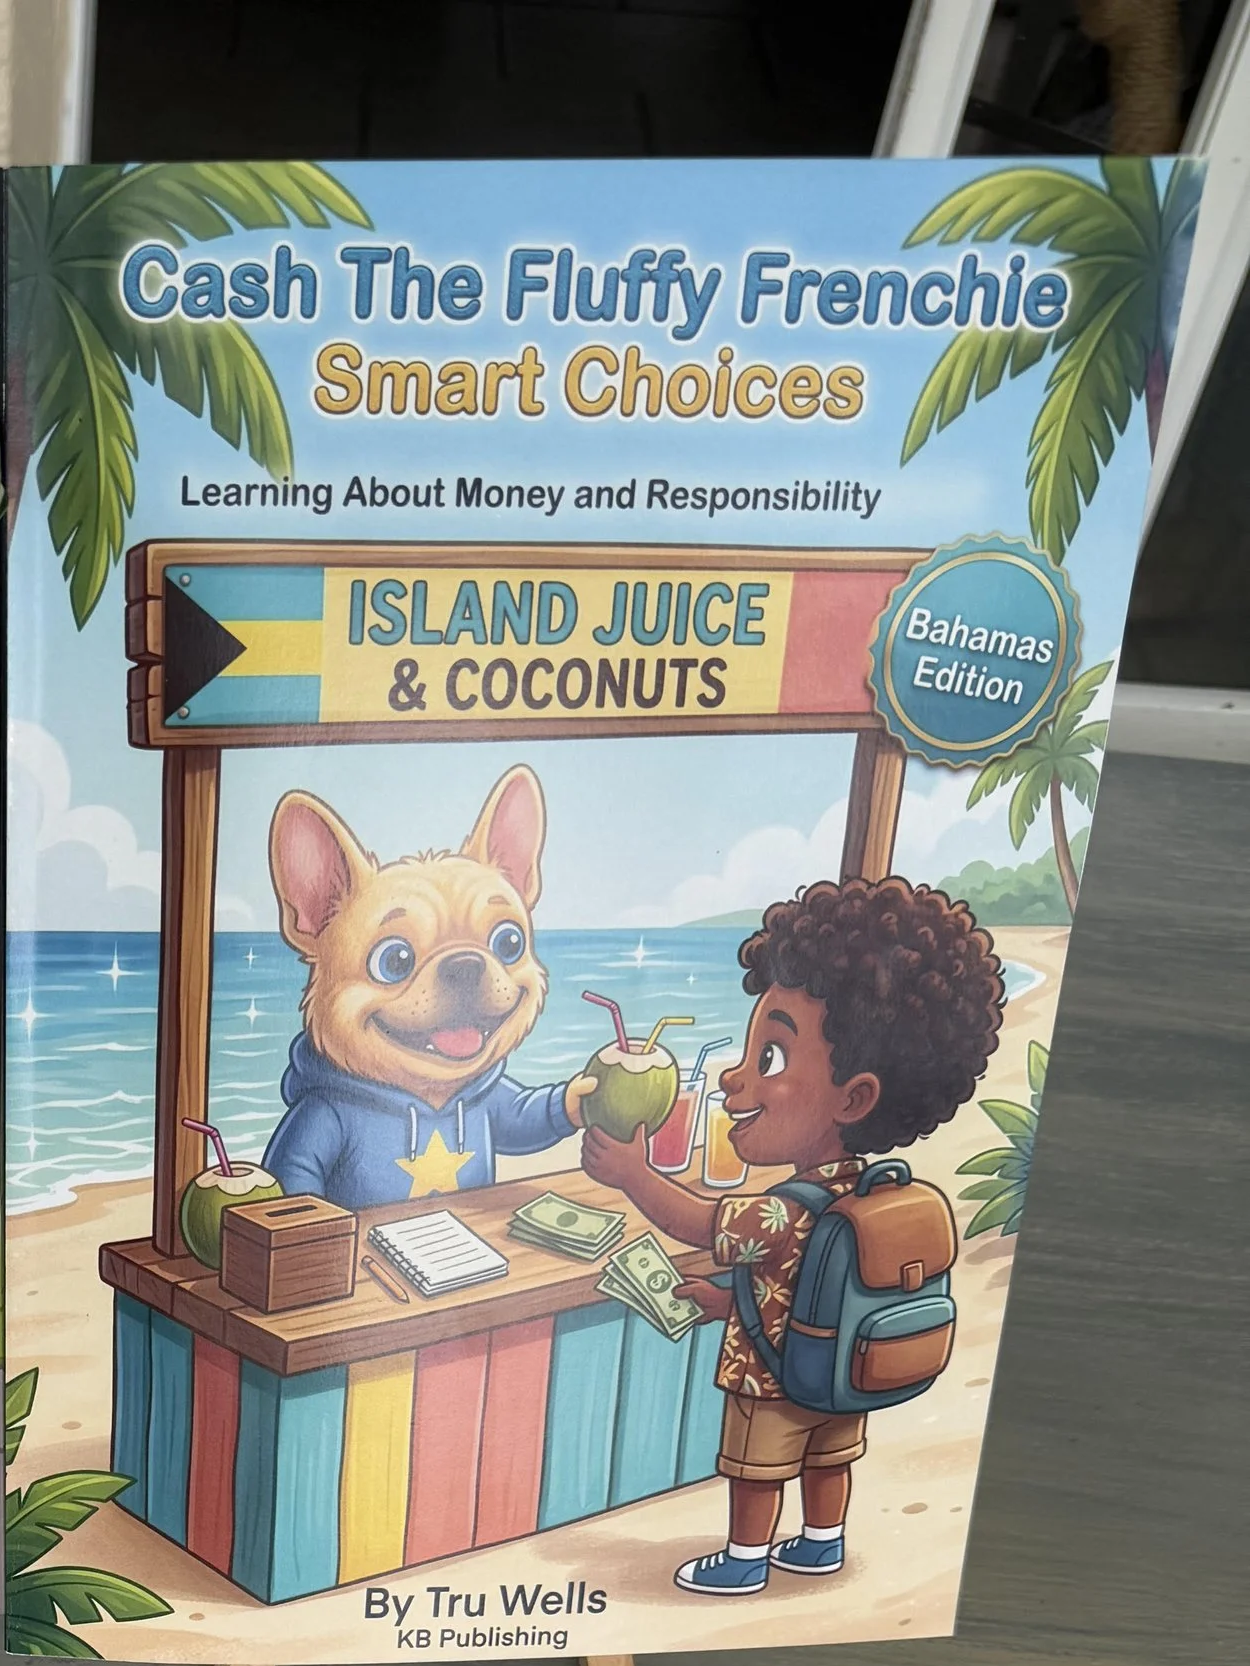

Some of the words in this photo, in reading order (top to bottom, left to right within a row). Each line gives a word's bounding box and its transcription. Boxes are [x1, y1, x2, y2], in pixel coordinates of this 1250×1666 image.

[120, 243, 317, 323] Cash
[340, 246, 481, 324] The
[504, 247, 720, 341] Fluffy
[741, 251, 1069, 333] Frenchie
[313, 341, 545, 418] Smart
[564, 345, 864, 421] Choices
[180, 475, 333, 515] Learning
[343, 477, 446, 510] About
[454, 478, 565, 516] Money
[573, 480, 637, 511] and
[645, 480, 881, 520] Responsibility
[347, 578, 577, 648] ISLAND
[591, 579, 770, 646] JUICE
[905, 607, 1055, 666] Bahamas
[387, 658, 428, 710] &
[445, 658, 727, 710] COCONUTS
[911, 658, 1024, 706] Edition
[364, 1587, 414, 1626] By
[426, 1586, 485, 1618] Tru
[499, 1581, 607, 1616] Wells
[397, 1629, 431, 1649] KB
[439, 1626, 569, 1649] Publishing
